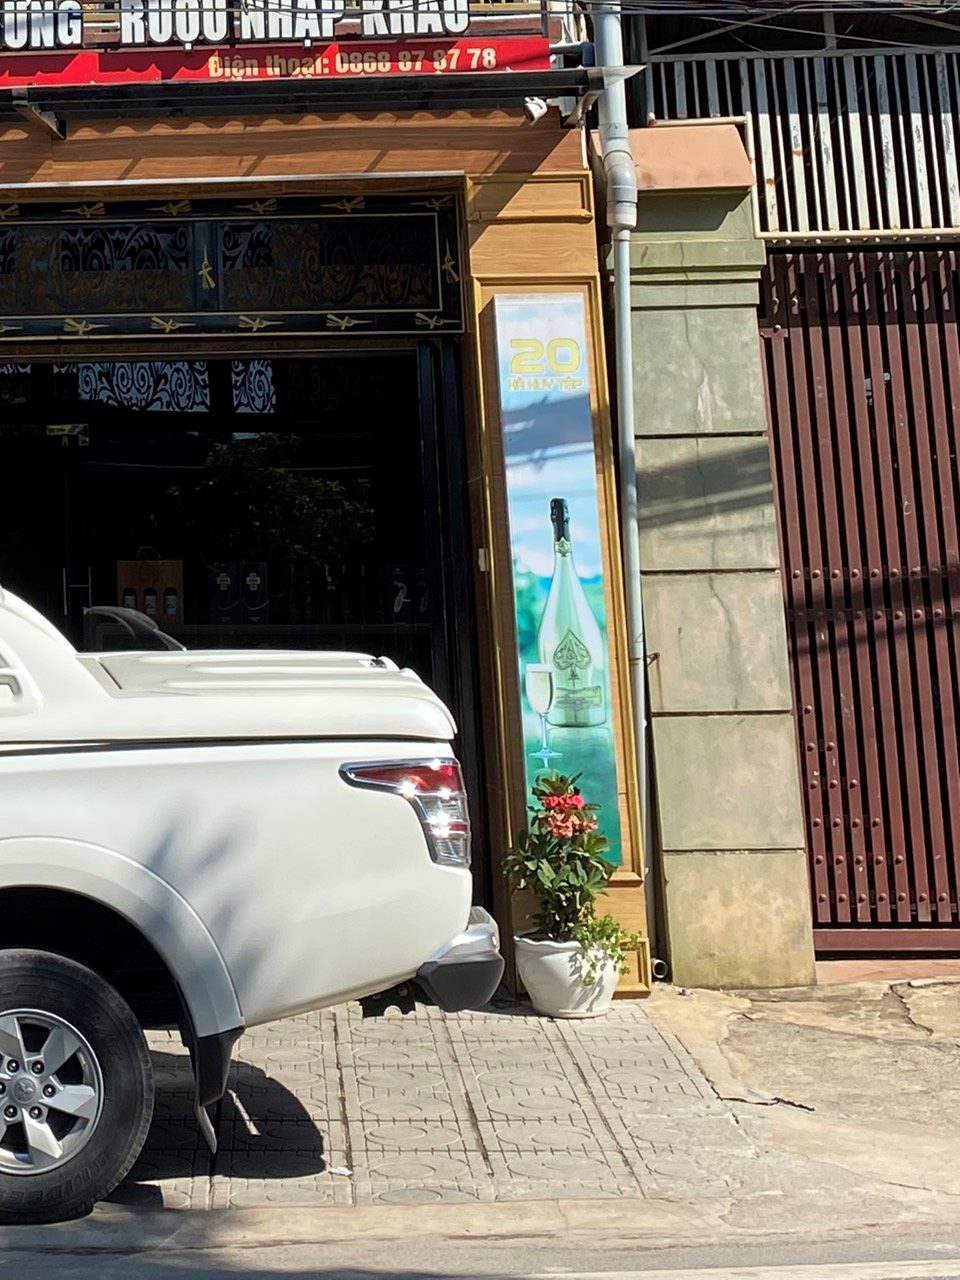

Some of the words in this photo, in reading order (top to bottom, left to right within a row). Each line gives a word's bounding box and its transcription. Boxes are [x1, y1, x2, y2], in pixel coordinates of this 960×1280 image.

[335, 48, 391, 74] 0868
[397, 48, 426, 72] 87
[433, 47, 460, 71] 87
[466, 46, 498, 70] 78
[510, 337, 581, 374] 20
